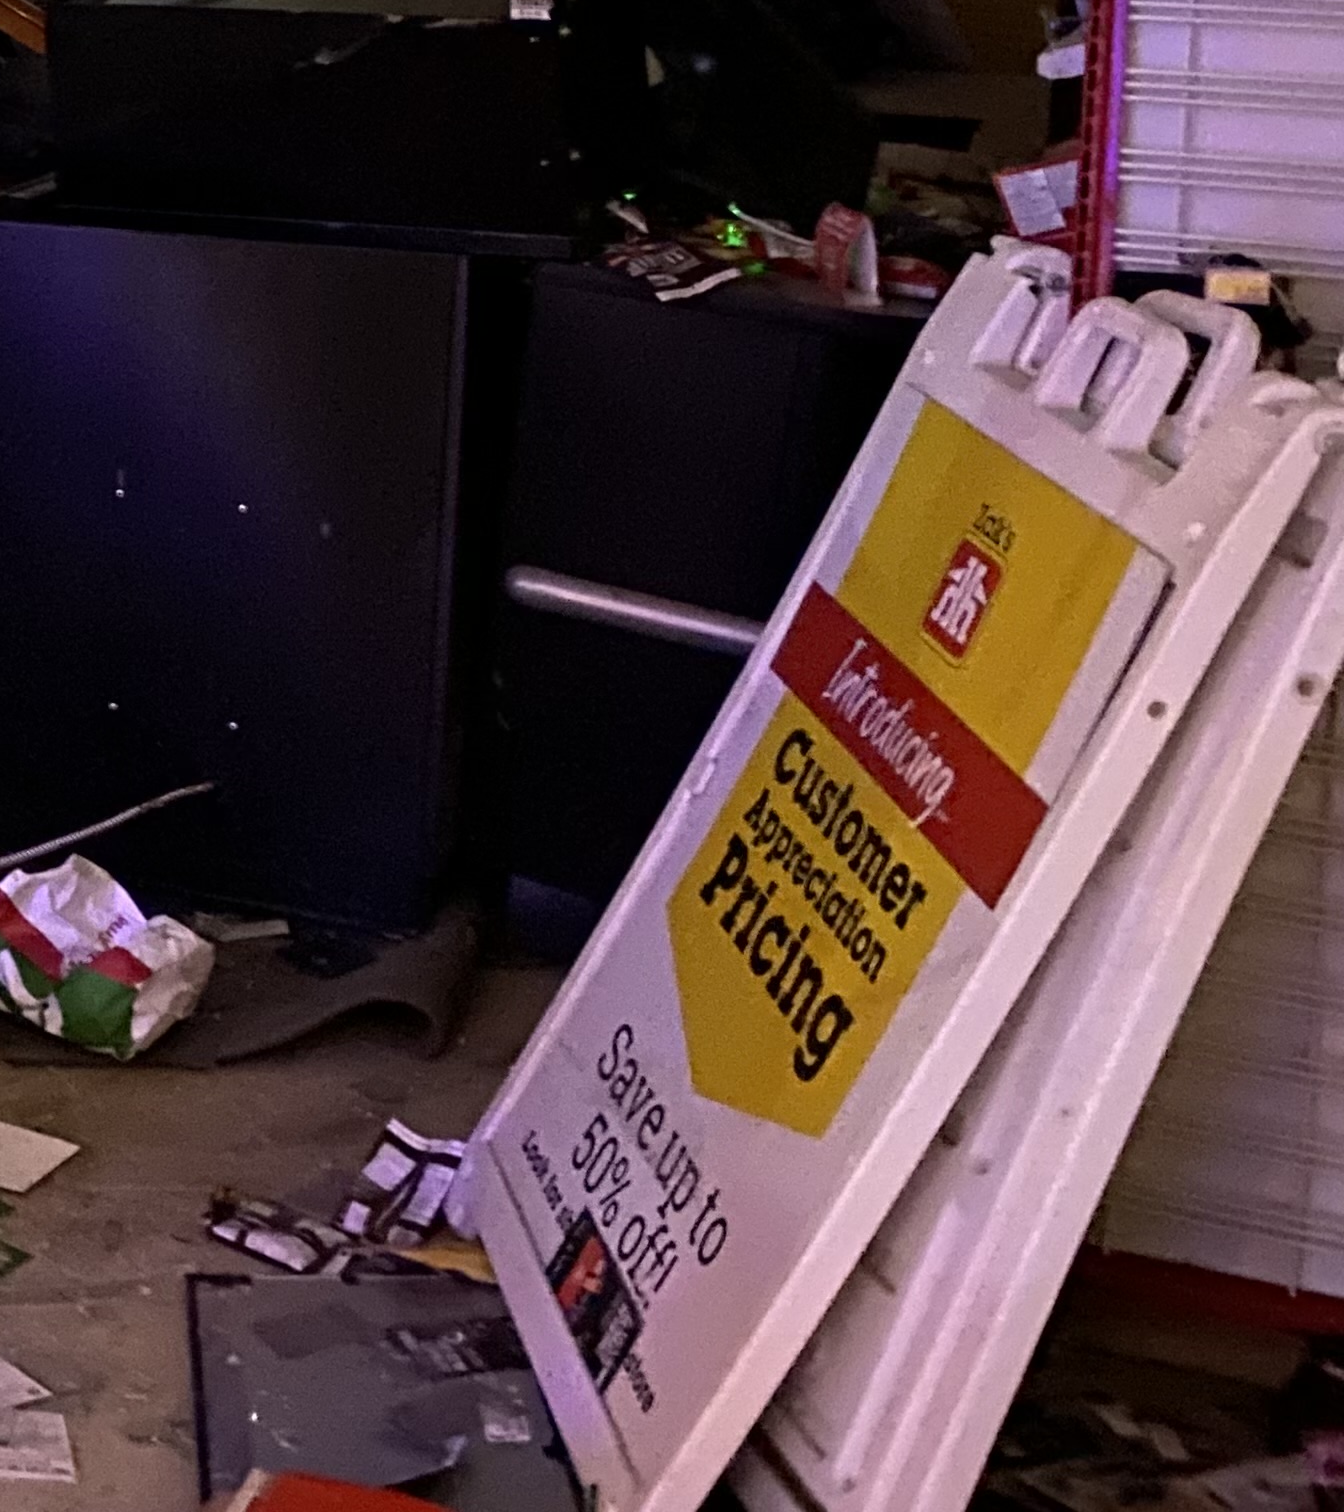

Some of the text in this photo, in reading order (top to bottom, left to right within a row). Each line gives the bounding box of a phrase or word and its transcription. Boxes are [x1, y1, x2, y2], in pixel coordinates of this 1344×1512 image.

[743, 788, 887, 985] Appreciation
[774, 727, 928, 930] Customer
[699, 831, 856, 1083] Pricing
[571, 1112, 631, 1228] 50%
[597, 1023, 728, 1266] Save up to
